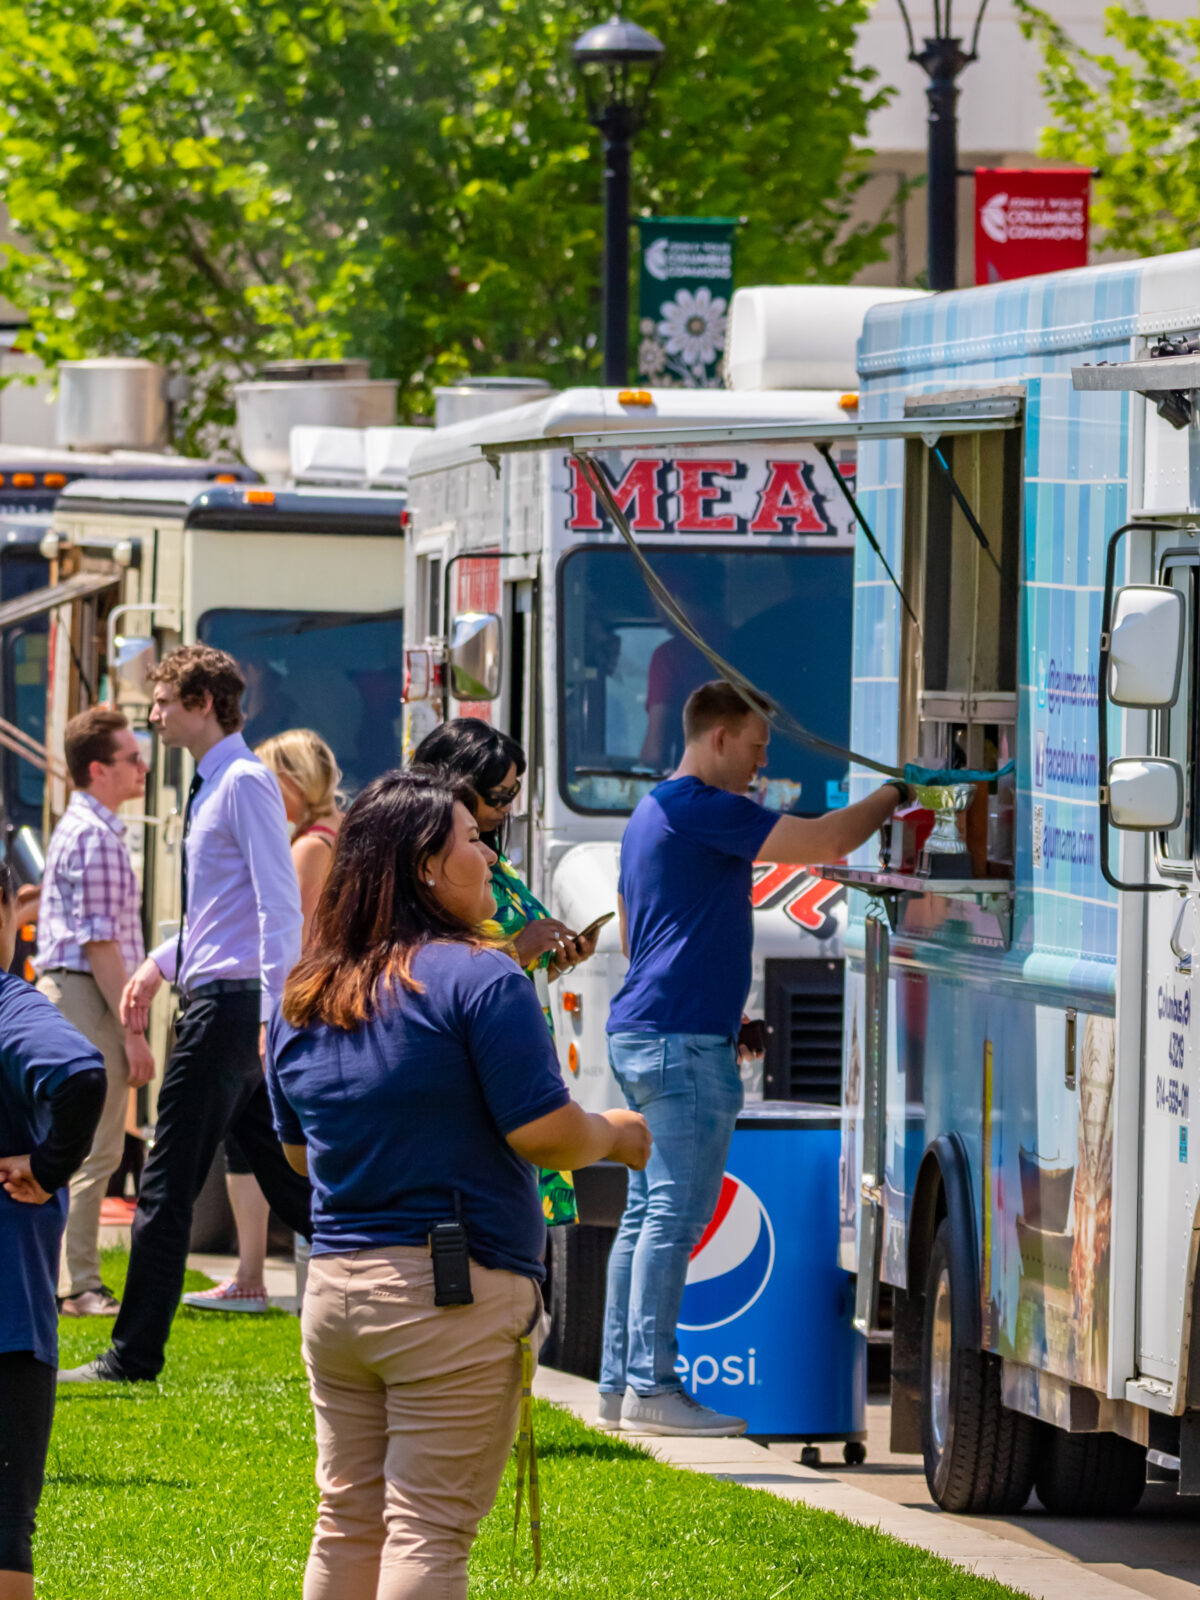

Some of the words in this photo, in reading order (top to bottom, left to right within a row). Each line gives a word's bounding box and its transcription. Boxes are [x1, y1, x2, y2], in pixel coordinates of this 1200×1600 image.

[1008, 210, 1083, 225] COLUMBUS
[1008, 225, 1083, 241] COMMONS
[564, 456, 856, 536] MEA
[674, 1347, 757, 1394] epsi
